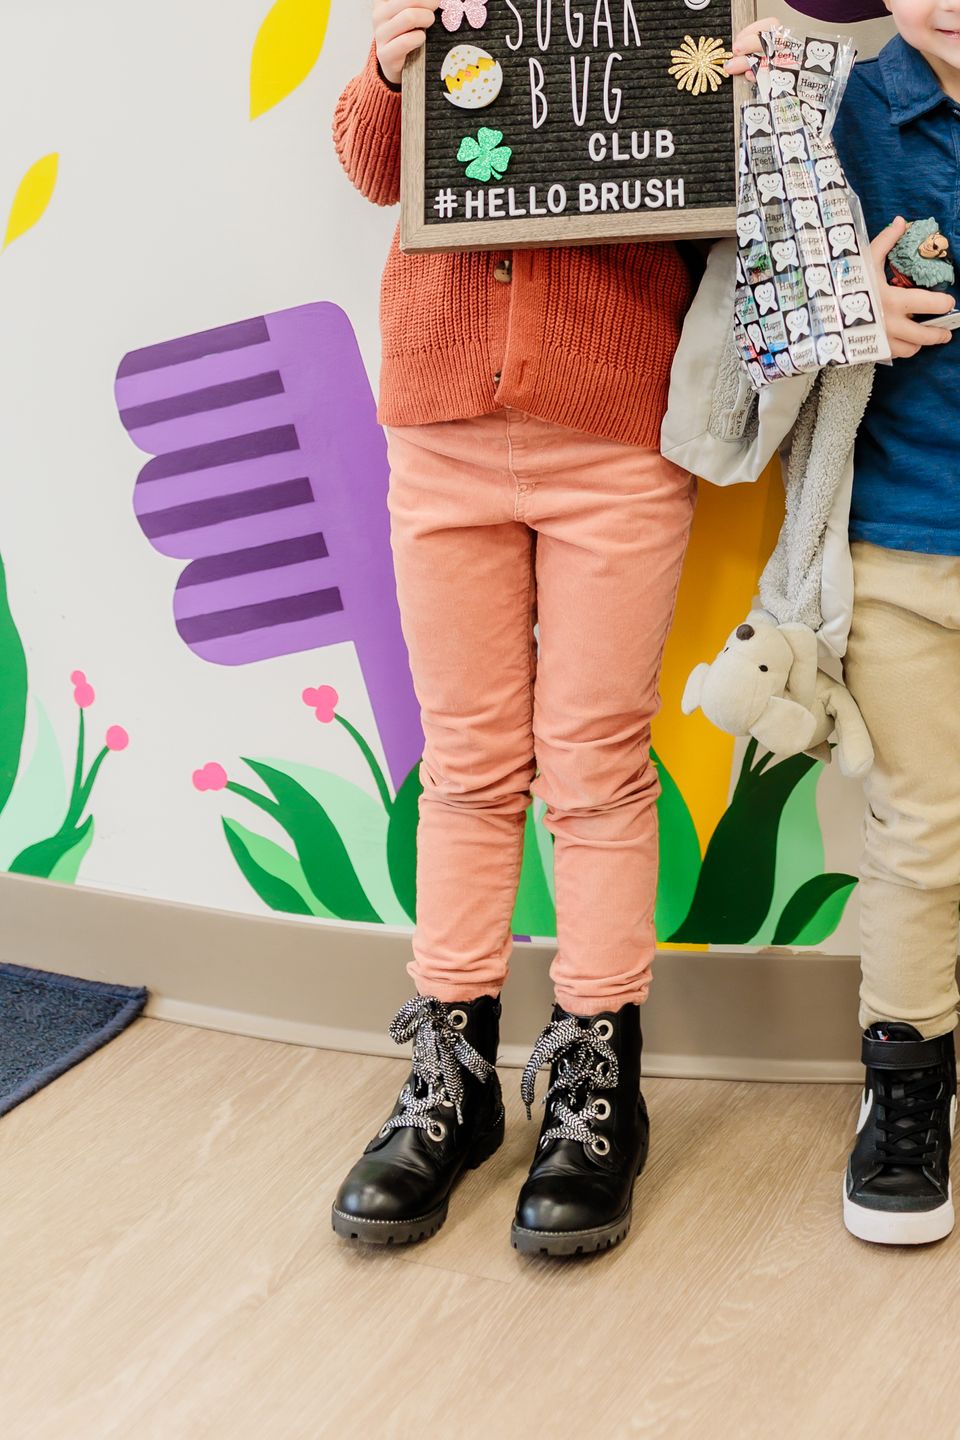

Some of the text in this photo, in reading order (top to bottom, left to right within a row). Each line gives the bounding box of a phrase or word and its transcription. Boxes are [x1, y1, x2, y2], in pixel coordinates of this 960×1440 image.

[775, 38, 802, 49] Happy
[529, 53, 622, 129] BUG
[588, 129, 675, 162] CLUB
[434, 178, 685, 219] #HELLO BRUSH
[848, 335, 876, 345] Happy
[851, 345, 879, 357] Teeth!
